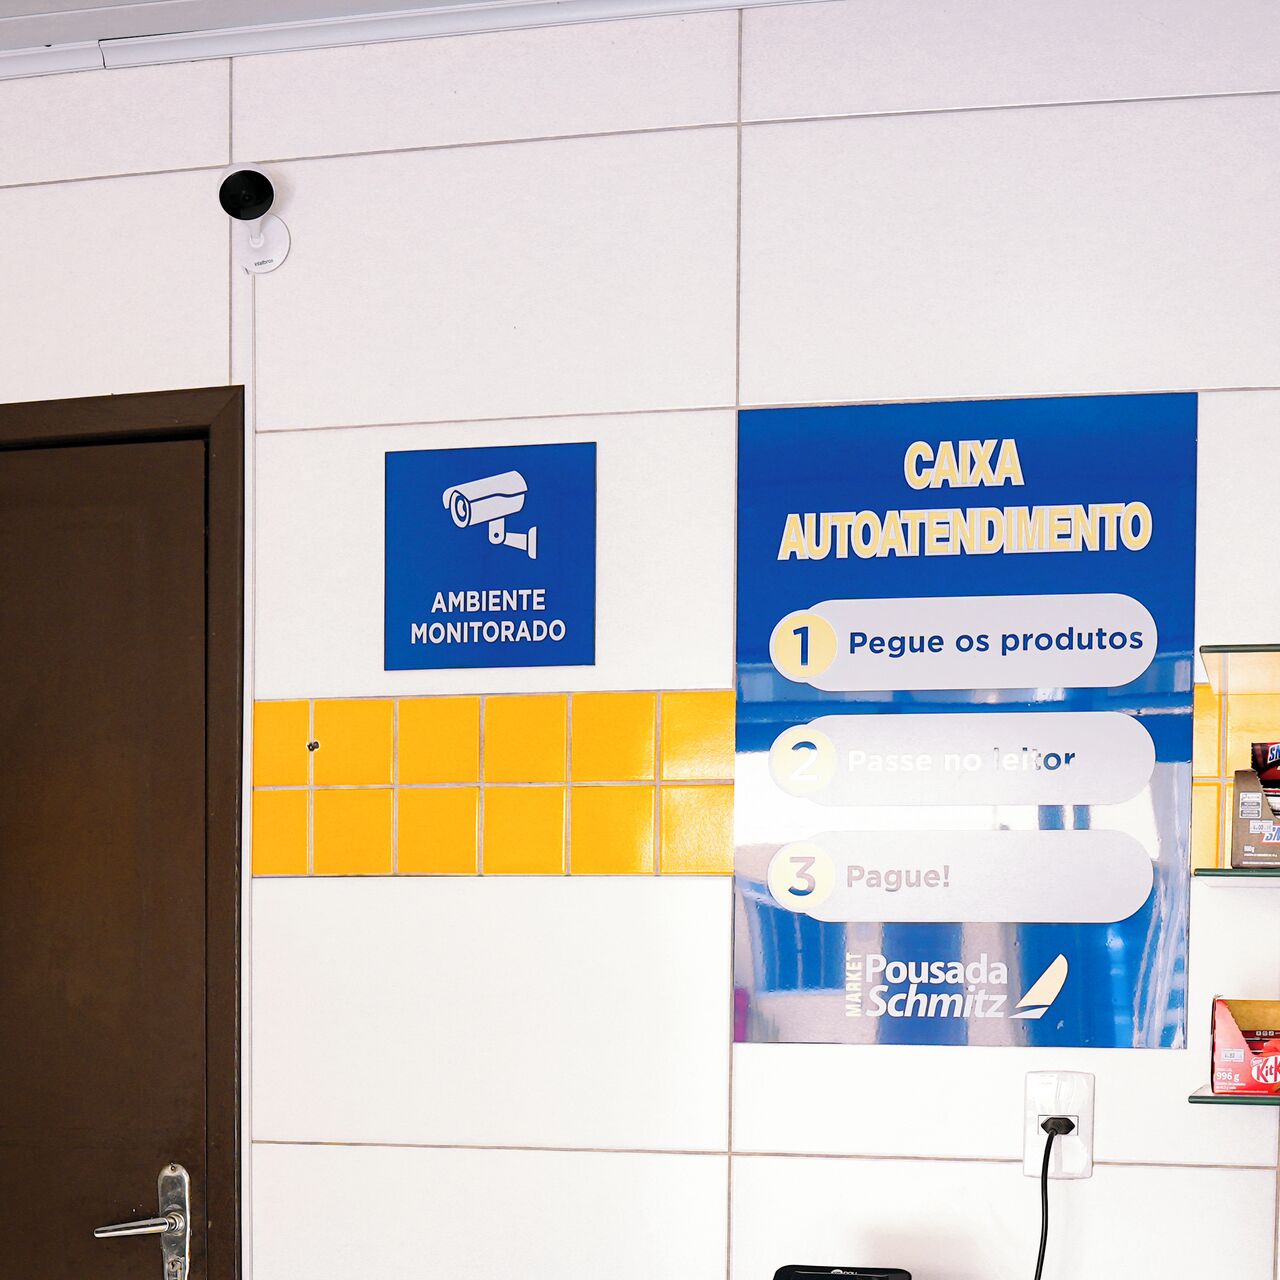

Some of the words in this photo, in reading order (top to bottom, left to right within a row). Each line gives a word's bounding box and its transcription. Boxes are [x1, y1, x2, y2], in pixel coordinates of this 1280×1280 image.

[904, 439, 1024, 490] CAIXA
[777, 501, 1152, 561] AUTOATENDIMENTO
[431, 589, 545, 613] AMBIENTE
[411, 620, 566, 644] MONITORADO
[792, 626, 809, 666] 1
[849, 631, 944, 658] Pegue
[955, 632, 989, 653] os
[1001, 627, 1143, 656] produtos
[789, 741, 818, 781] 2
[848, 750, 932, 772] Passe
[944, 754, 980, 771] no
[993, 747, 1076, 771] leitor
[788, 856, 816, 896] 3
[847, 864, 950, 892] Pague!
[845, 952, 862, 1017] MARKET
[866, 953, 1008, 984] Pousada
[866, 983, 1008, 1018] Schmitz
[1216, 1072, 1232, 1080] 996
[1234, 1074, 1239, 1082] g
